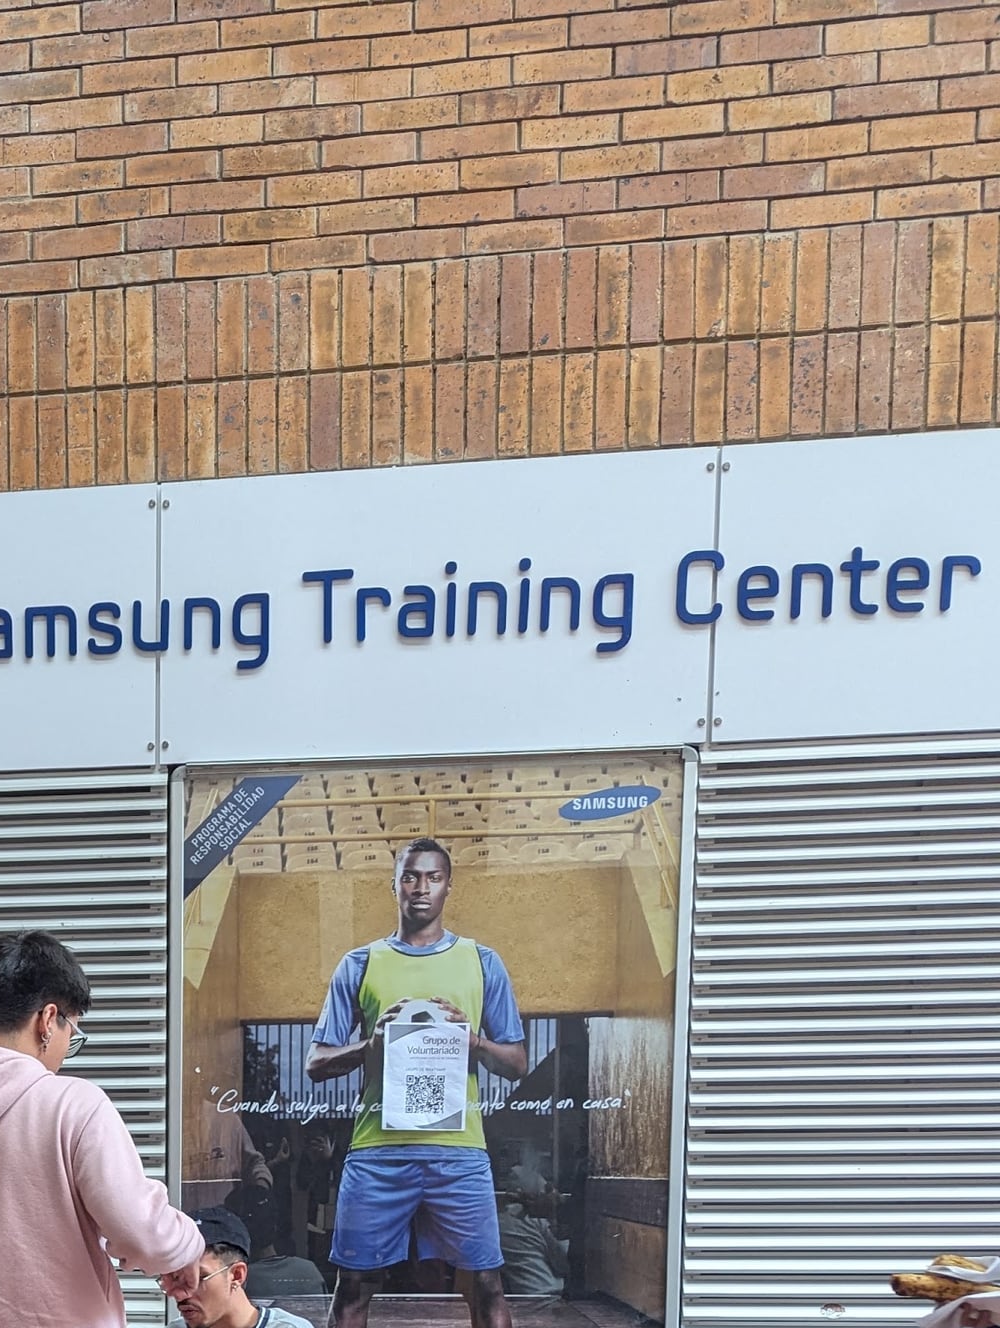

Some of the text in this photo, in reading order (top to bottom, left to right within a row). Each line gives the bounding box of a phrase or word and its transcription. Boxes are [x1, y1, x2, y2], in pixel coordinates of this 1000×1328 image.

[302, 558, 634, 652] Training
[677, 547, 981, 624] Center
[191, 788, 249, 848] PROGRAMA DE
[572, 796, 648, 810] SAMSUNG
[190, 786, 265, 865] RESPONSABILIDAD
[219, 817, 252, 851] SOCIAL
[407, 1046, 460, 1055] Voluntariado
[422, 1036, 460, 1047] Grupo de
[286, 1093, 328, 1126] salgo
[336, 1102, 347, 1113] a
[350, 1094, 364, 1113] la
[556, 1098, 574, 1109] en
